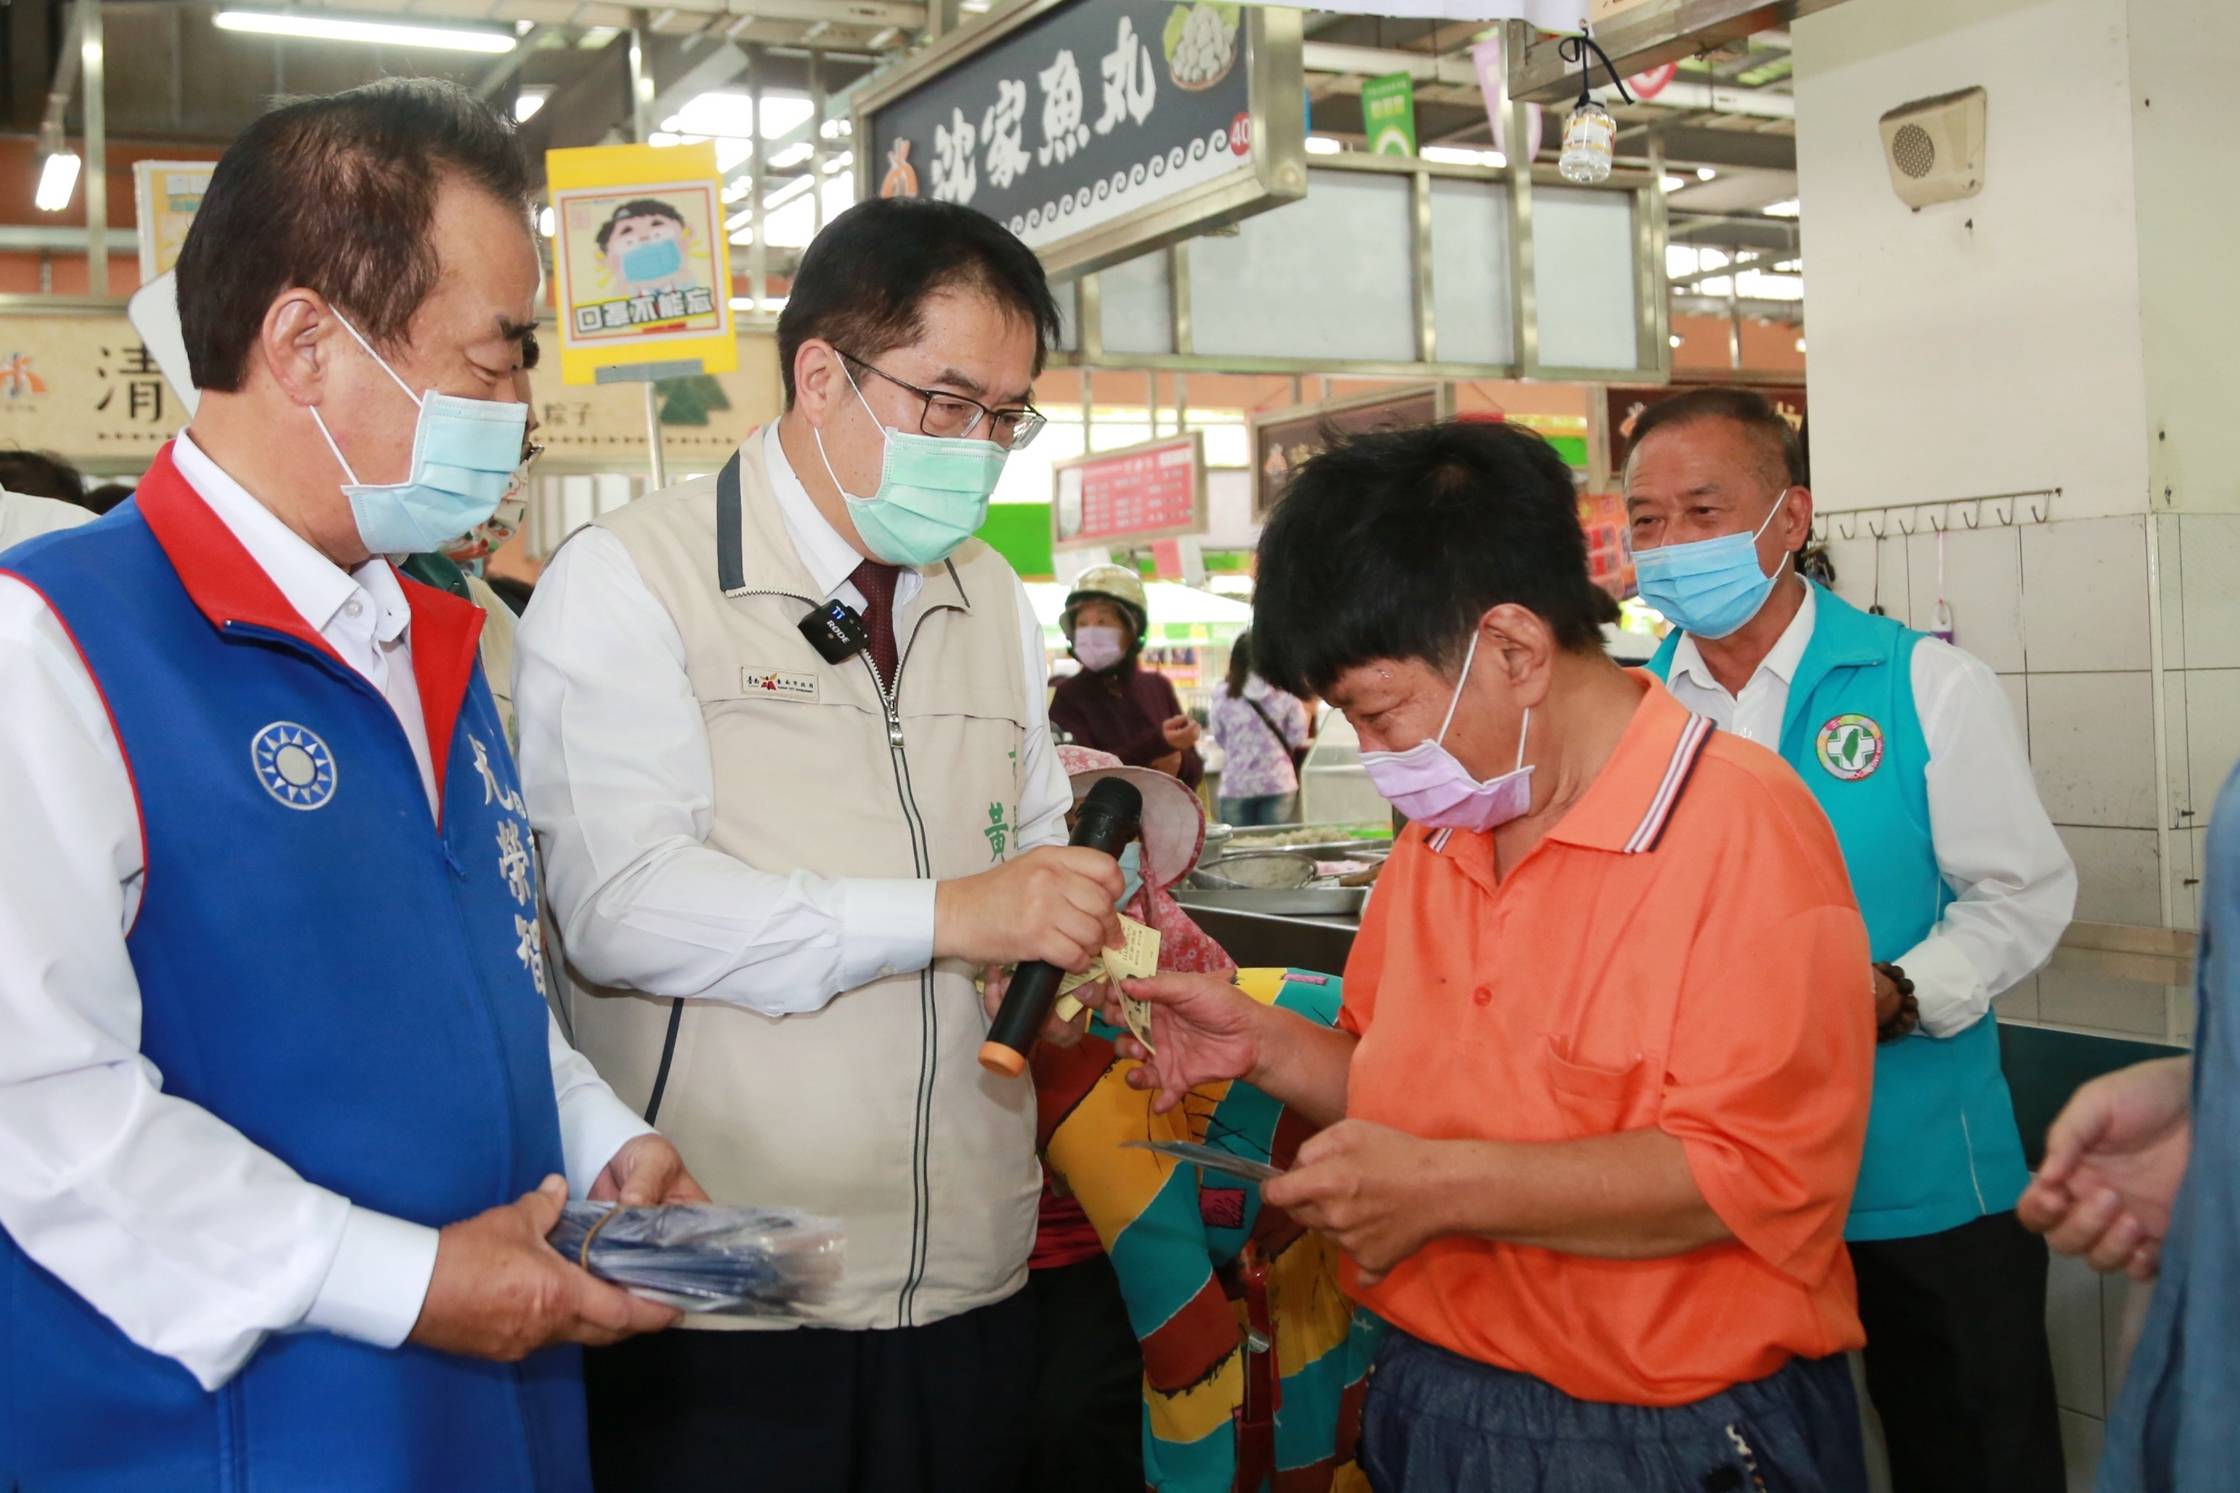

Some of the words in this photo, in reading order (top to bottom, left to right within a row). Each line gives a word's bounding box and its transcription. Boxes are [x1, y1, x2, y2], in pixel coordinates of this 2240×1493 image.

[930, 15, 1156, 206] 沈家魚丸
[575, 287, 714, 334] 口罩不能忘
[96, 342, 163, 422] 清
[467, 733, 547, 998] 尤榮智
